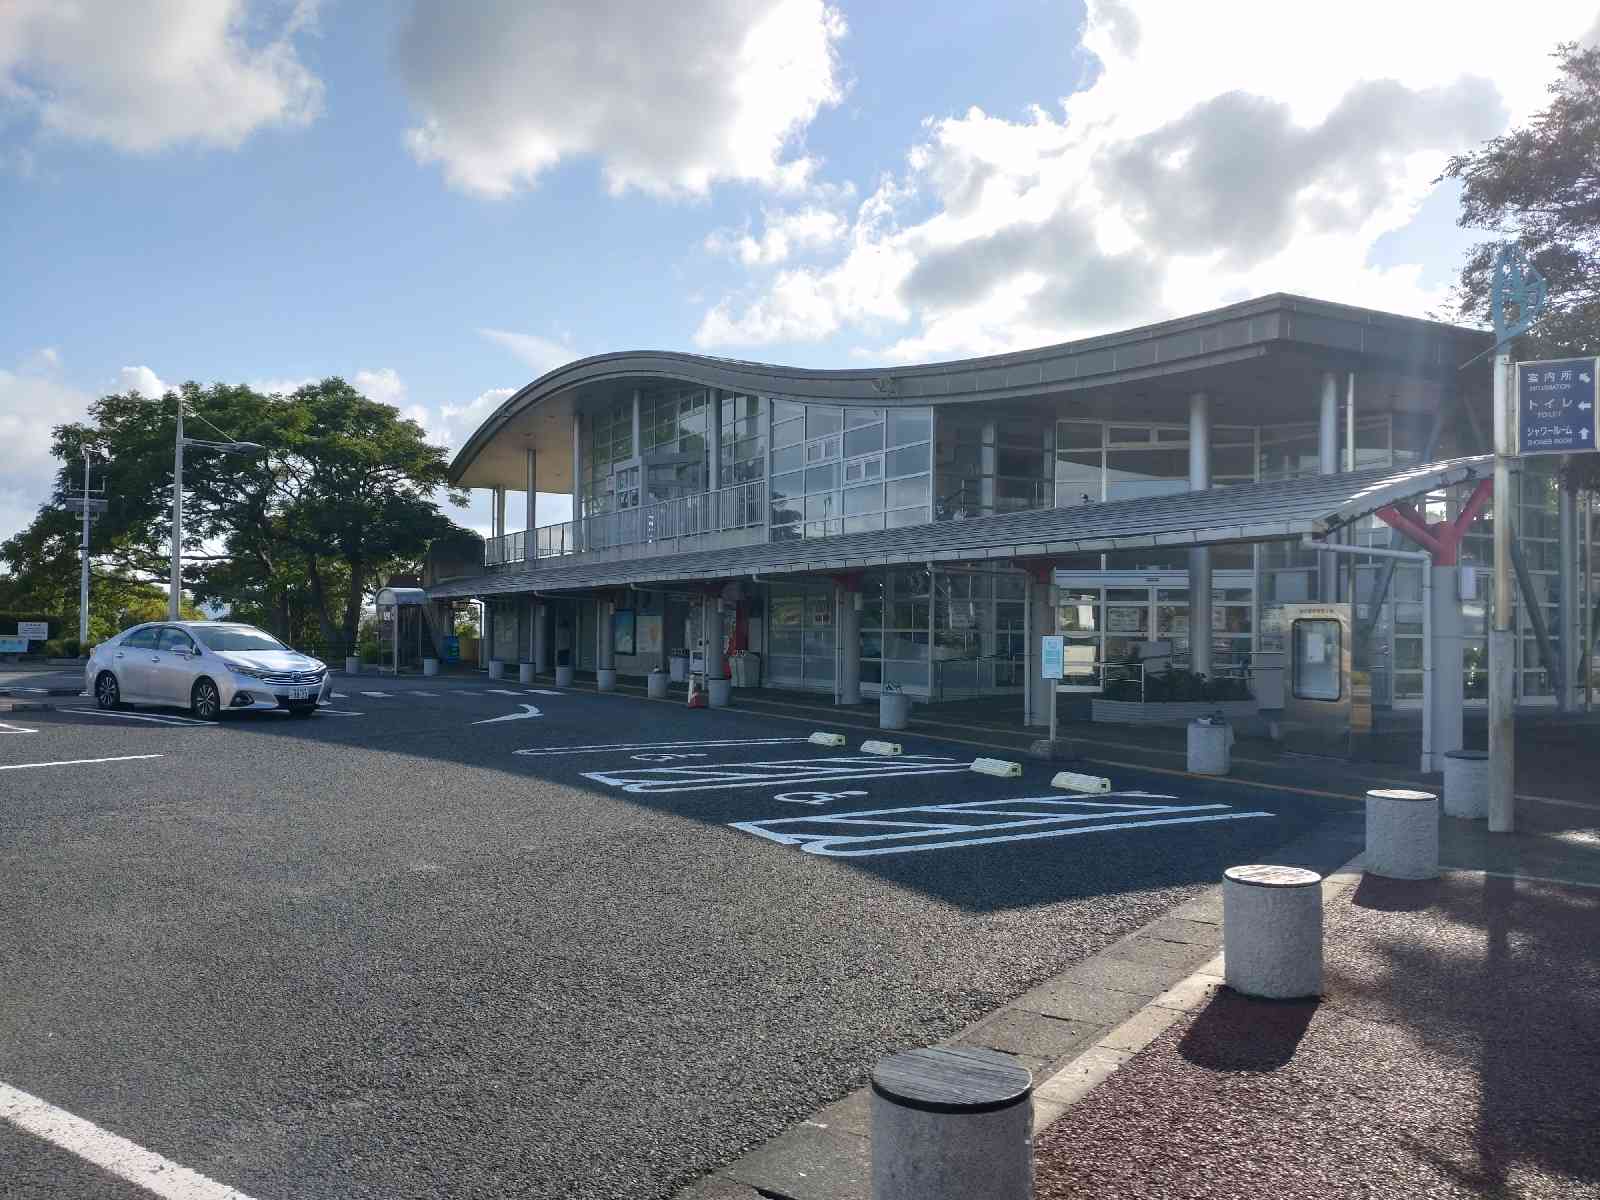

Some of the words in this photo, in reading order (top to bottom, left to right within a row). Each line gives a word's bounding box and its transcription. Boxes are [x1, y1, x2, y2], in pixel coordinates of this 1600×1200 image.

[1529, 398, 1573, 410] トイレ
[1528, 426, 1573, 437] シャワールーム
